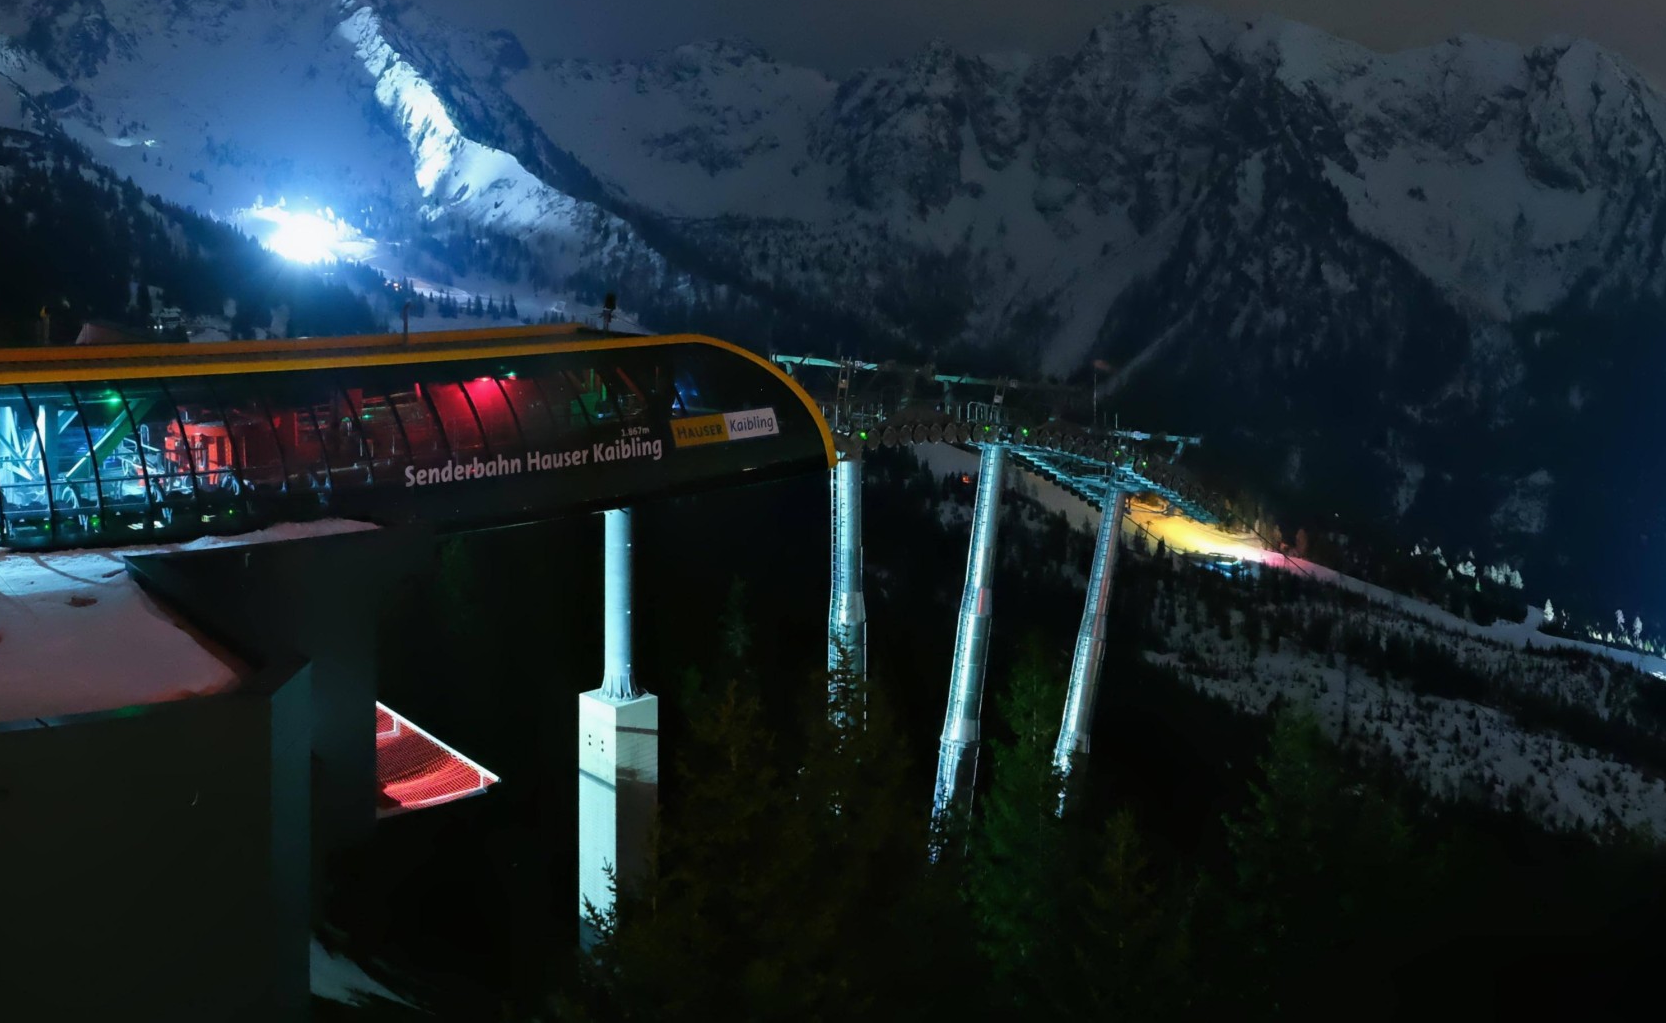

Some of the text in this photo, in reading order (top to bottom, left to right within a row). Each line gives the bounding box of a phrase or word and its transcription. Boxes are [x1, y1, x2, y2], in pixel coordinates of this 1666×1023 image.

[677, 416, 774, 440] HAUSER Kaibling
[405, 436, 663, 488] Senderbahn Hauser Kaibling
